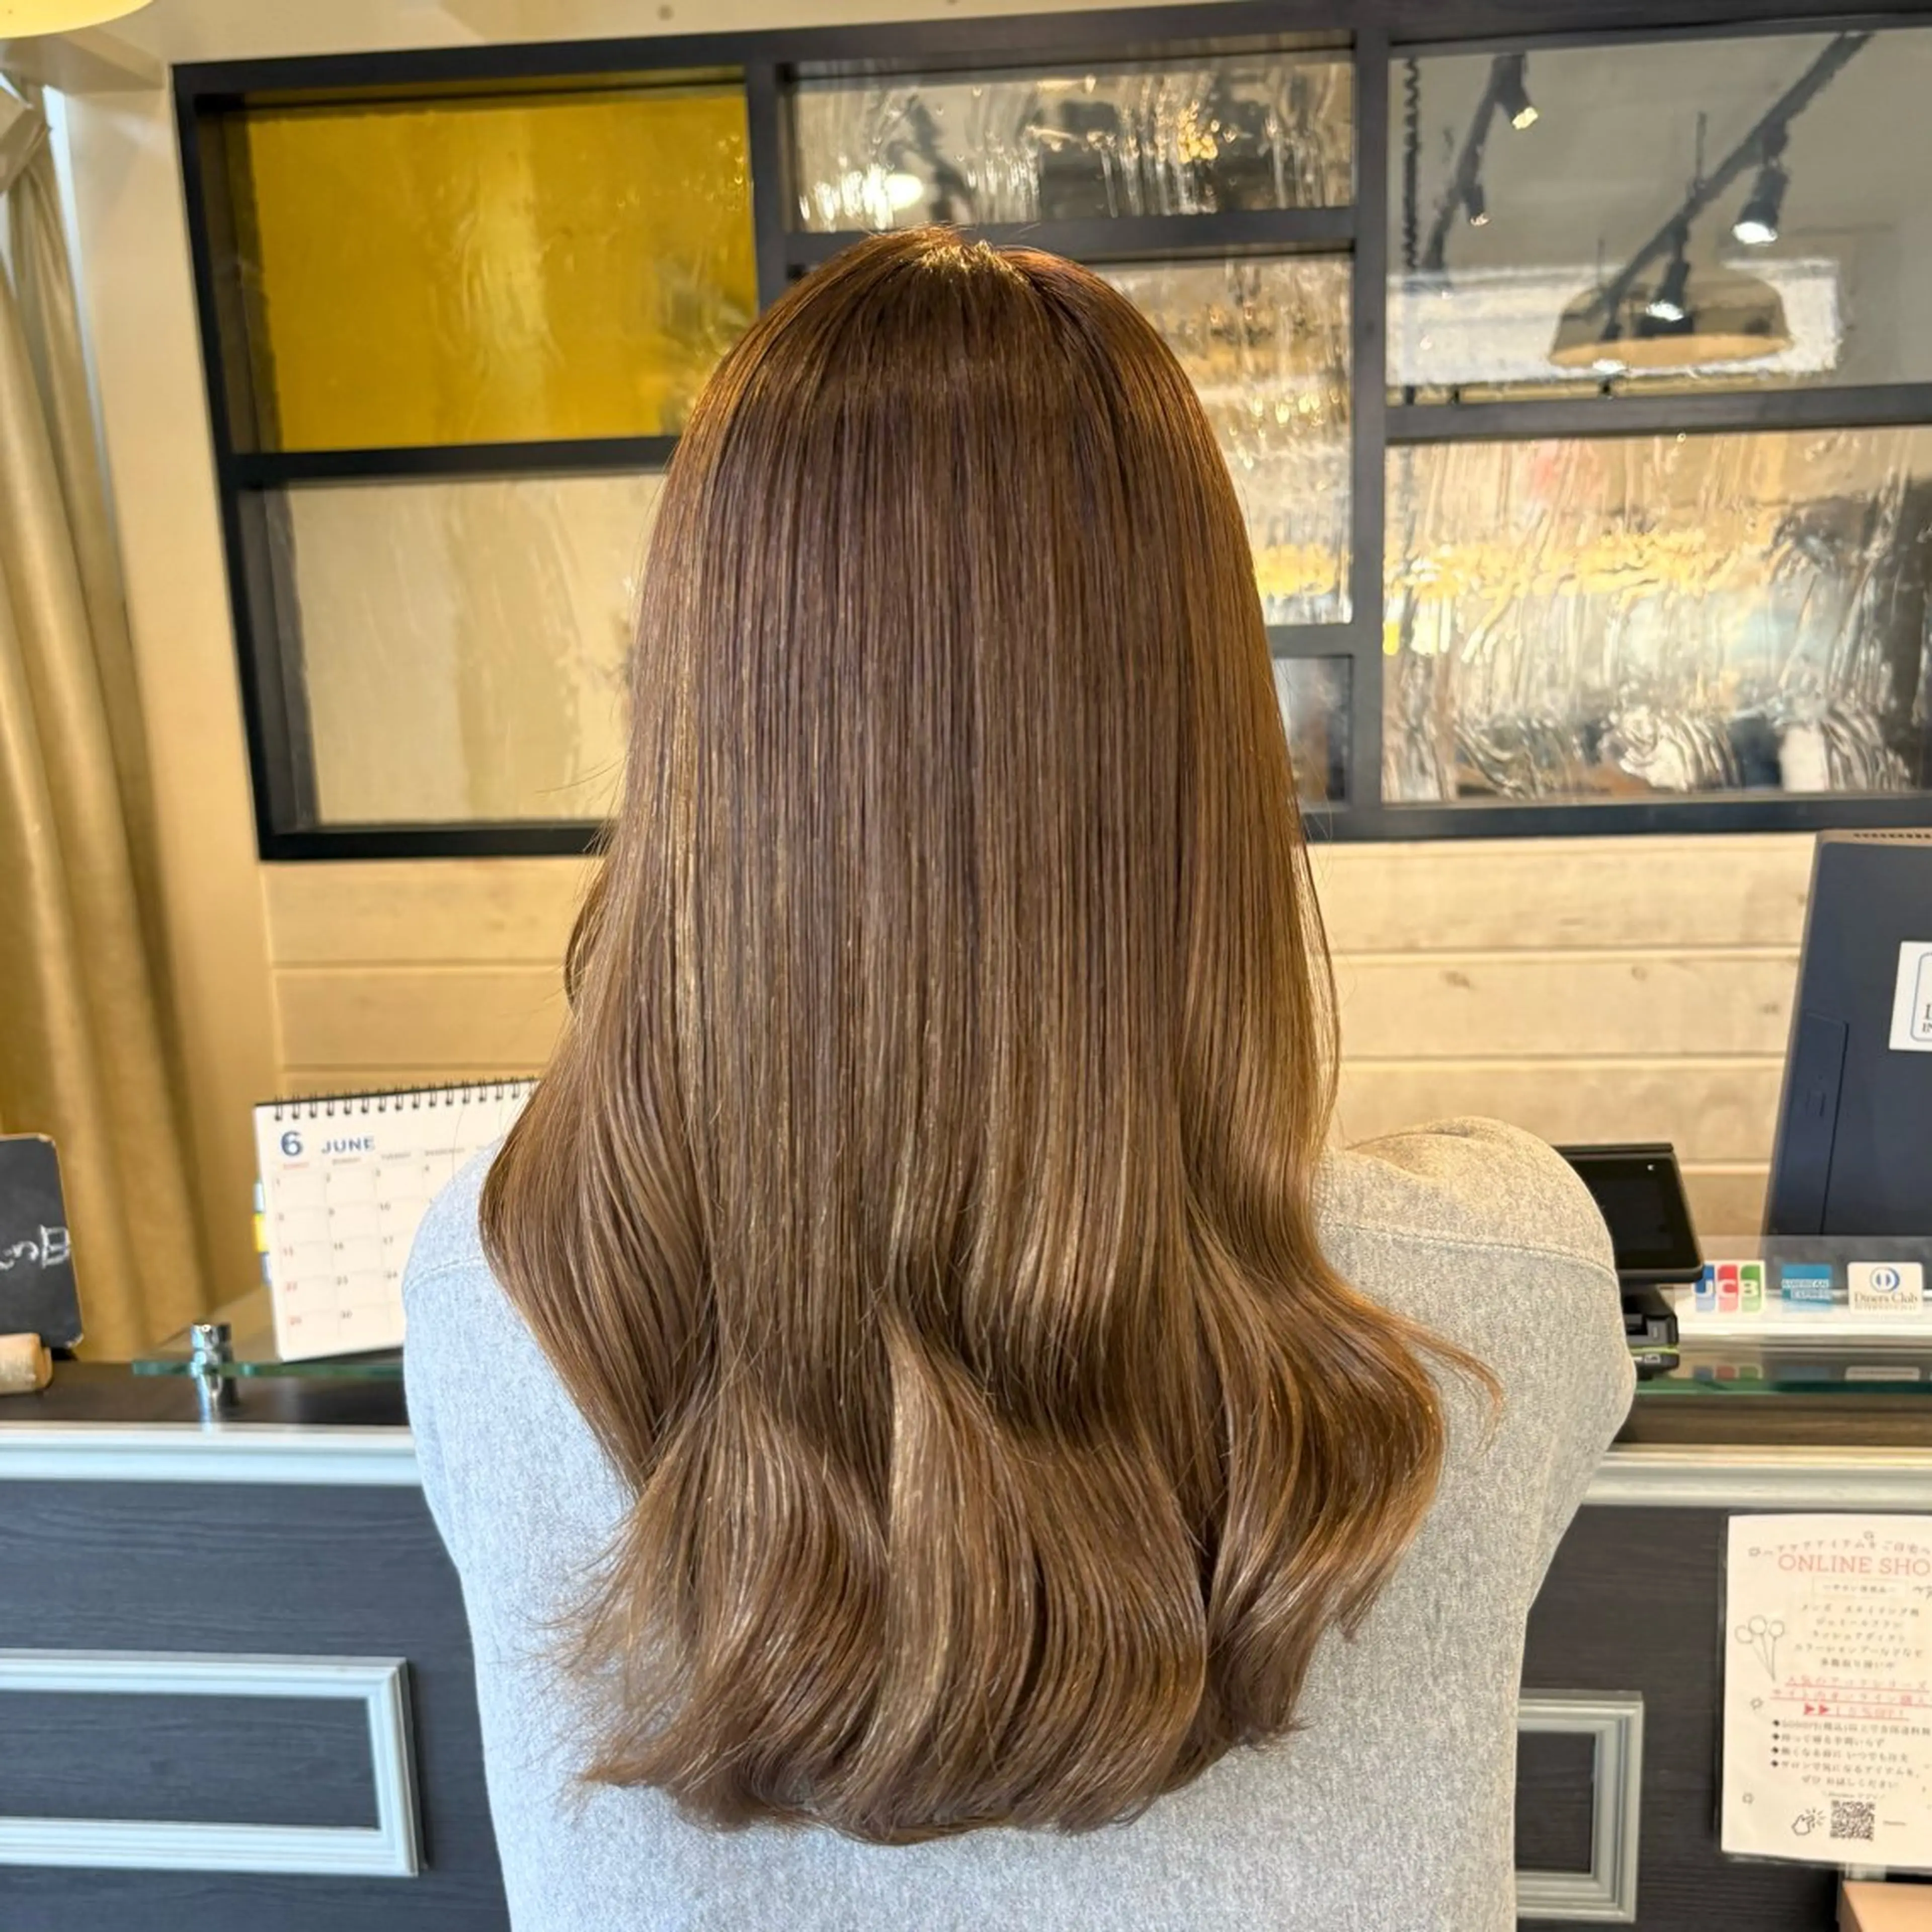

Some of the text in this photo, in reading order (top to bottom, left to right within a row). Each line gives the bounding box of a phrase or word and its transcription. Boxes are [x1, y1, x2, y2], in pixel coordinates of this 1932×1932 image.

[281, 1130, 376, 1157] 6 JUNE
[1854, 1291, 1918, 1304] Diners Club
[1778, 1553, 1931, 1576] ONLINE SHO
